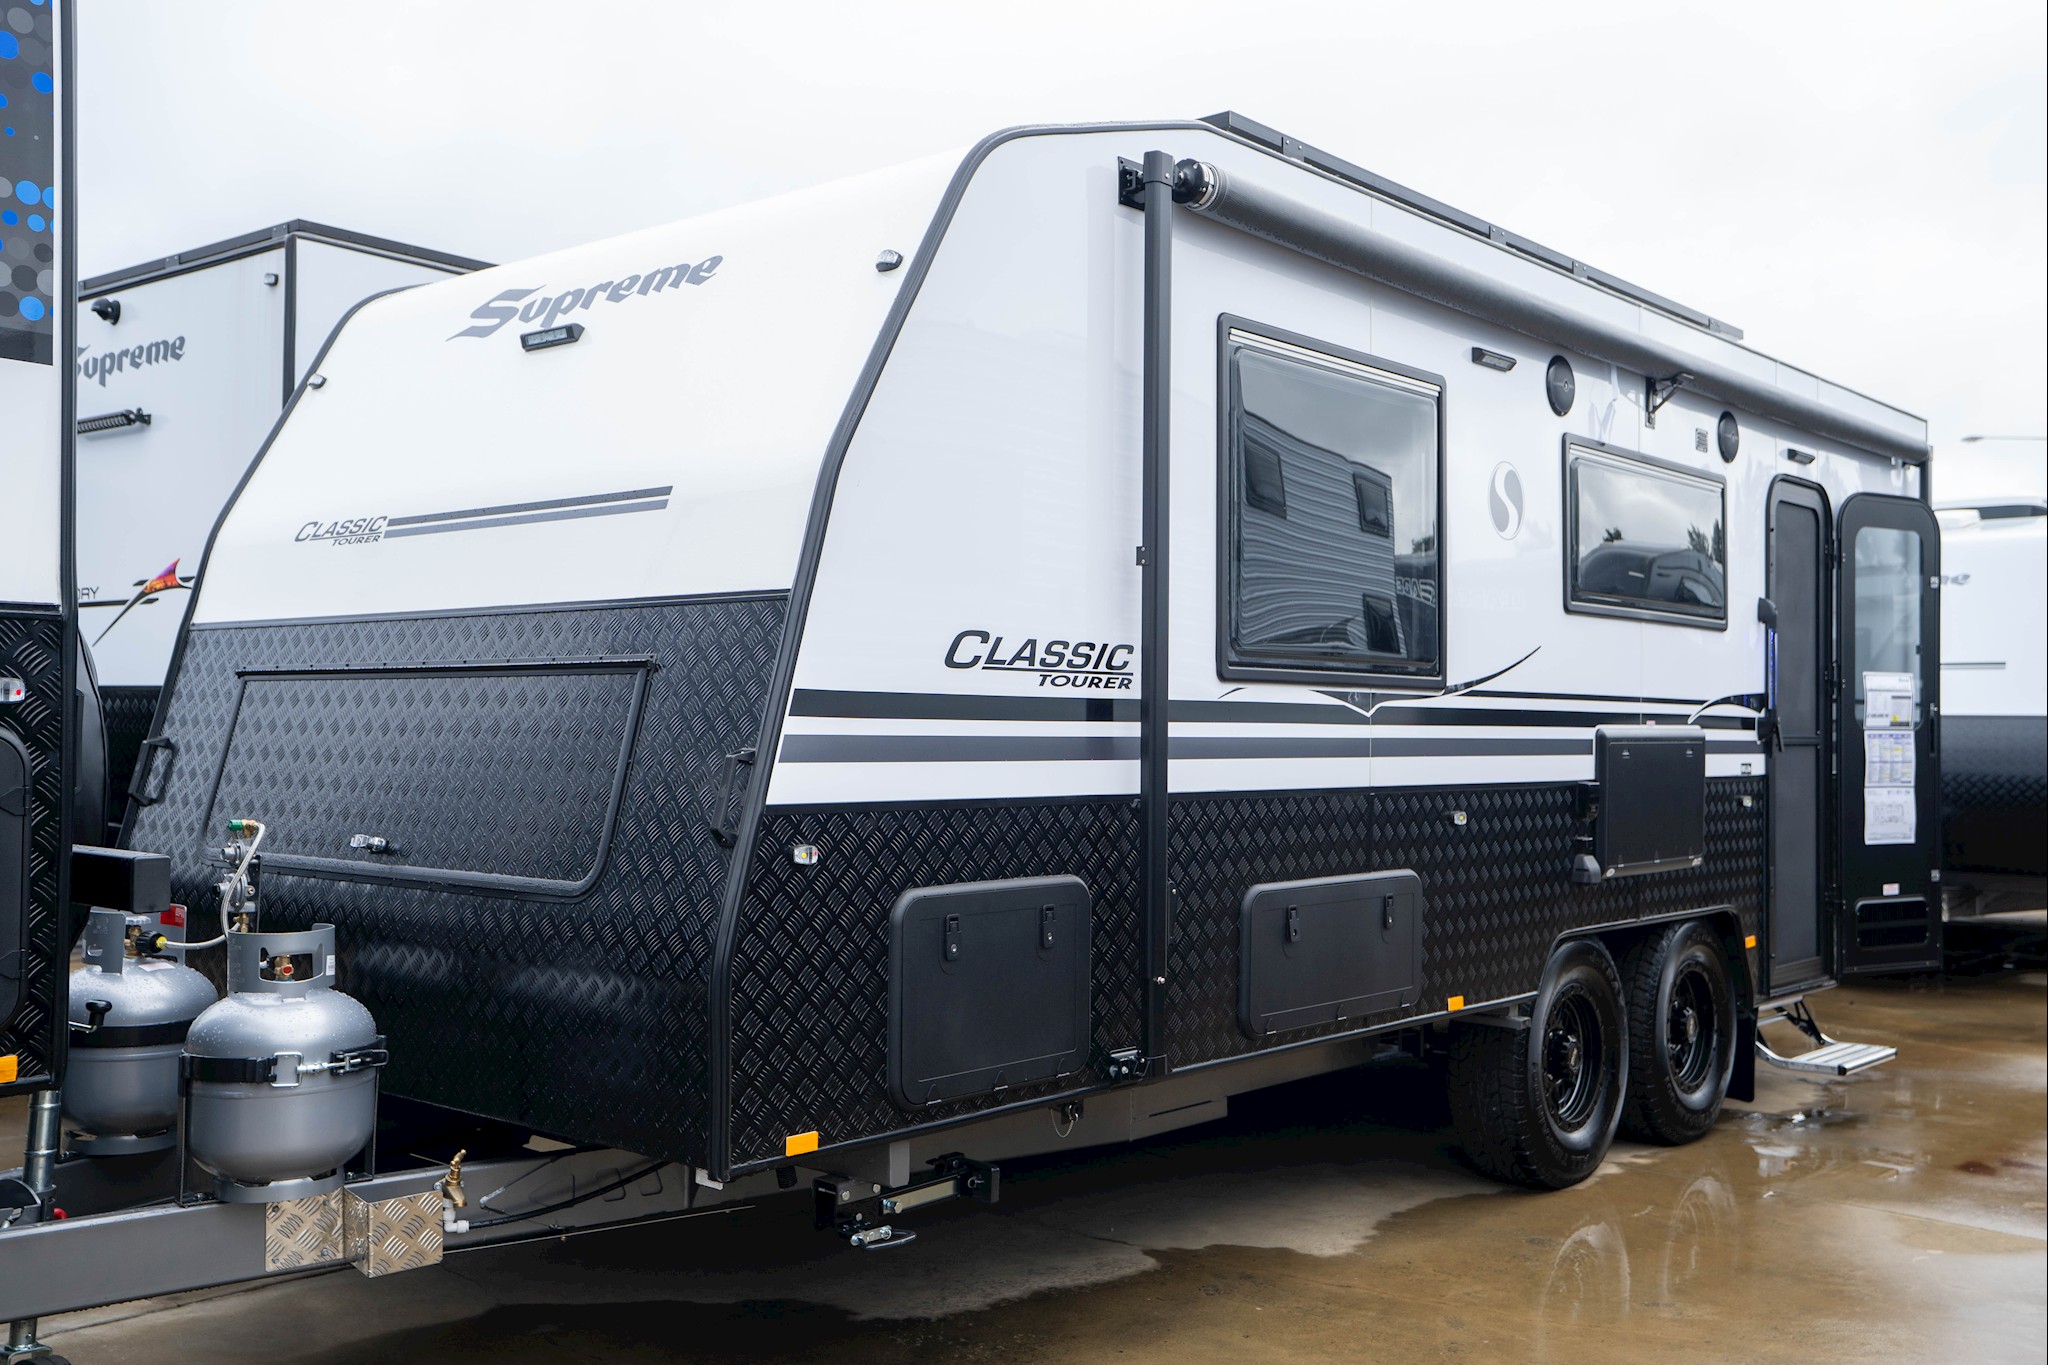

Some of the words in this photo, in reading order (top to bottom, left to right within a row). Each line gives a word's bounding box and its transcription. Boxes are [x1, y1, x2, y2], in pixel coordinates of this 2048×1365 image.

[446, 254, 723, 342] Supreme
[294, 516, 388, 542] CLASSIC
[332, 535, 381, 546] TOURER
[944, 629, 1135, 671] CLASSIC
[1038, 674, 1133, 690] TOURER
